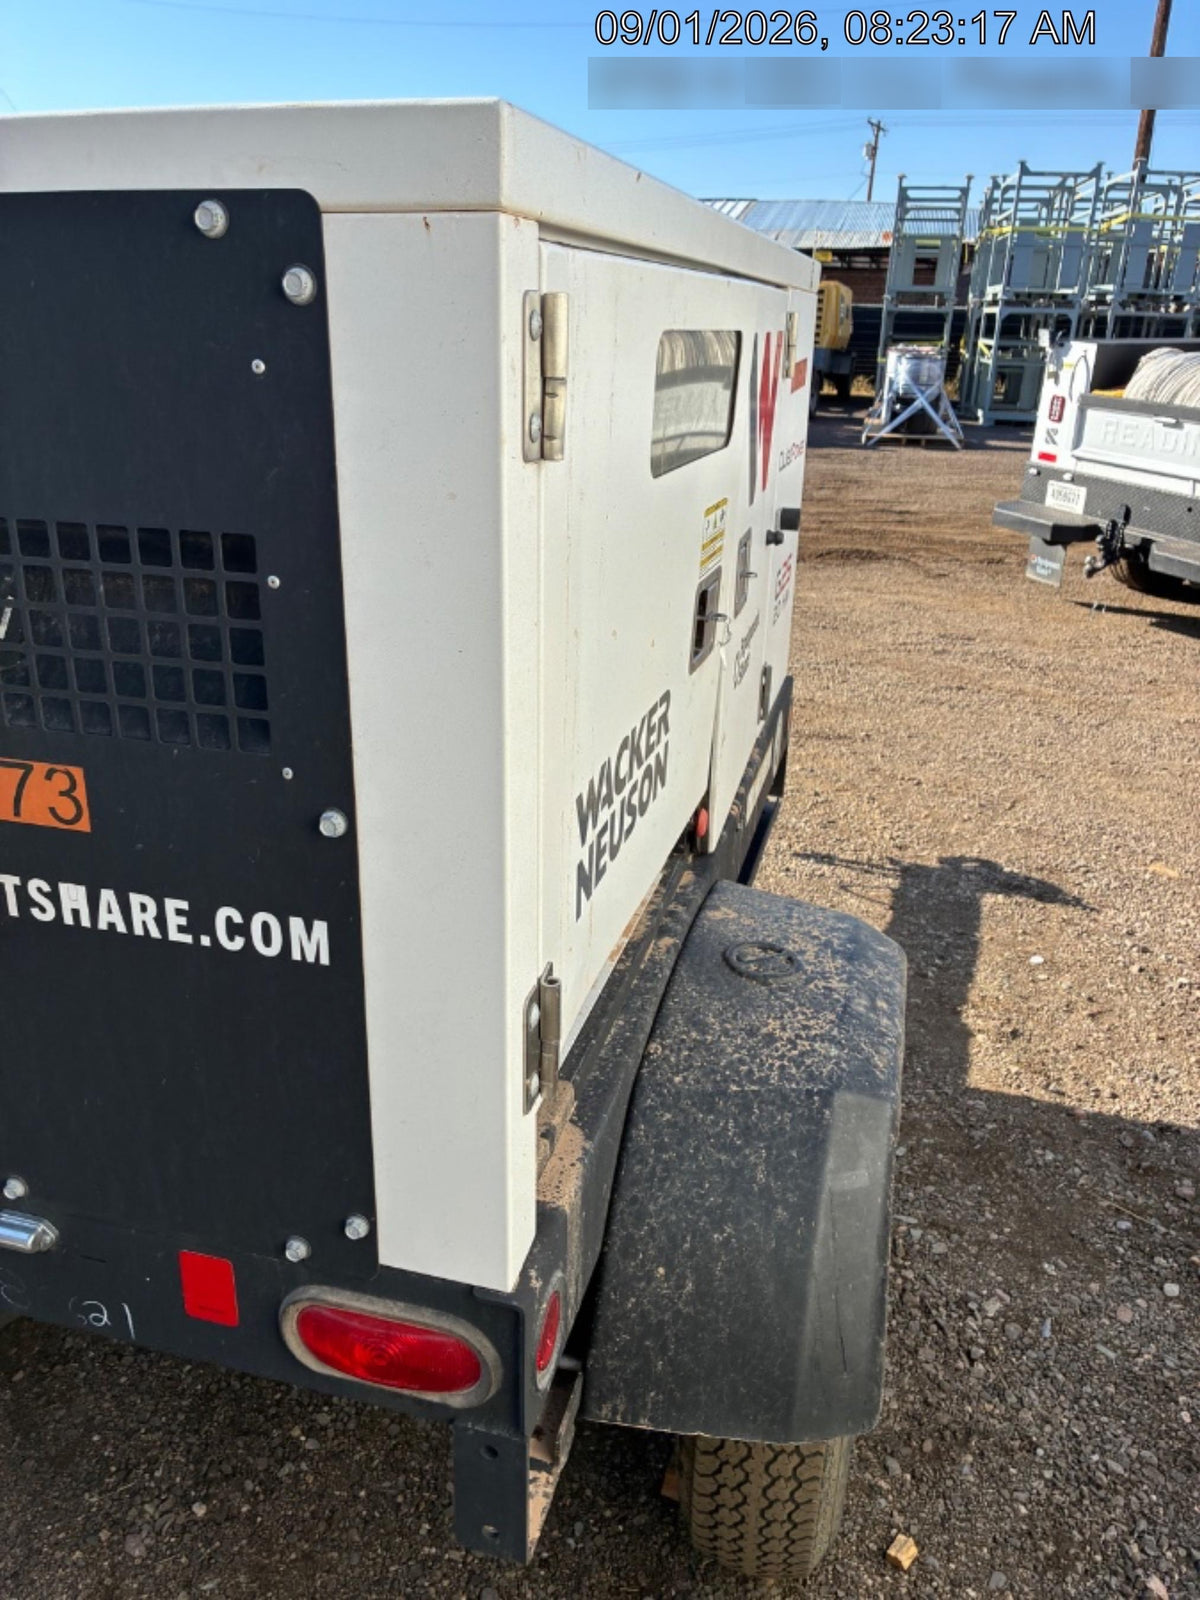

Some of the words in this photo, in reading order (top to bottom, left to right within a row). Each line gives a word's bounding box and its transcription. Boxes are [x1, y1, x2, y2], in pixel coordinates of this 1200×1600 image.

[0, 761, 84, 826] 73
[575, 689, 671, 849] WACKER
[575, 740, 669, 923] NEUSON
[0, 873, 330, 966] TSHARE.COM
